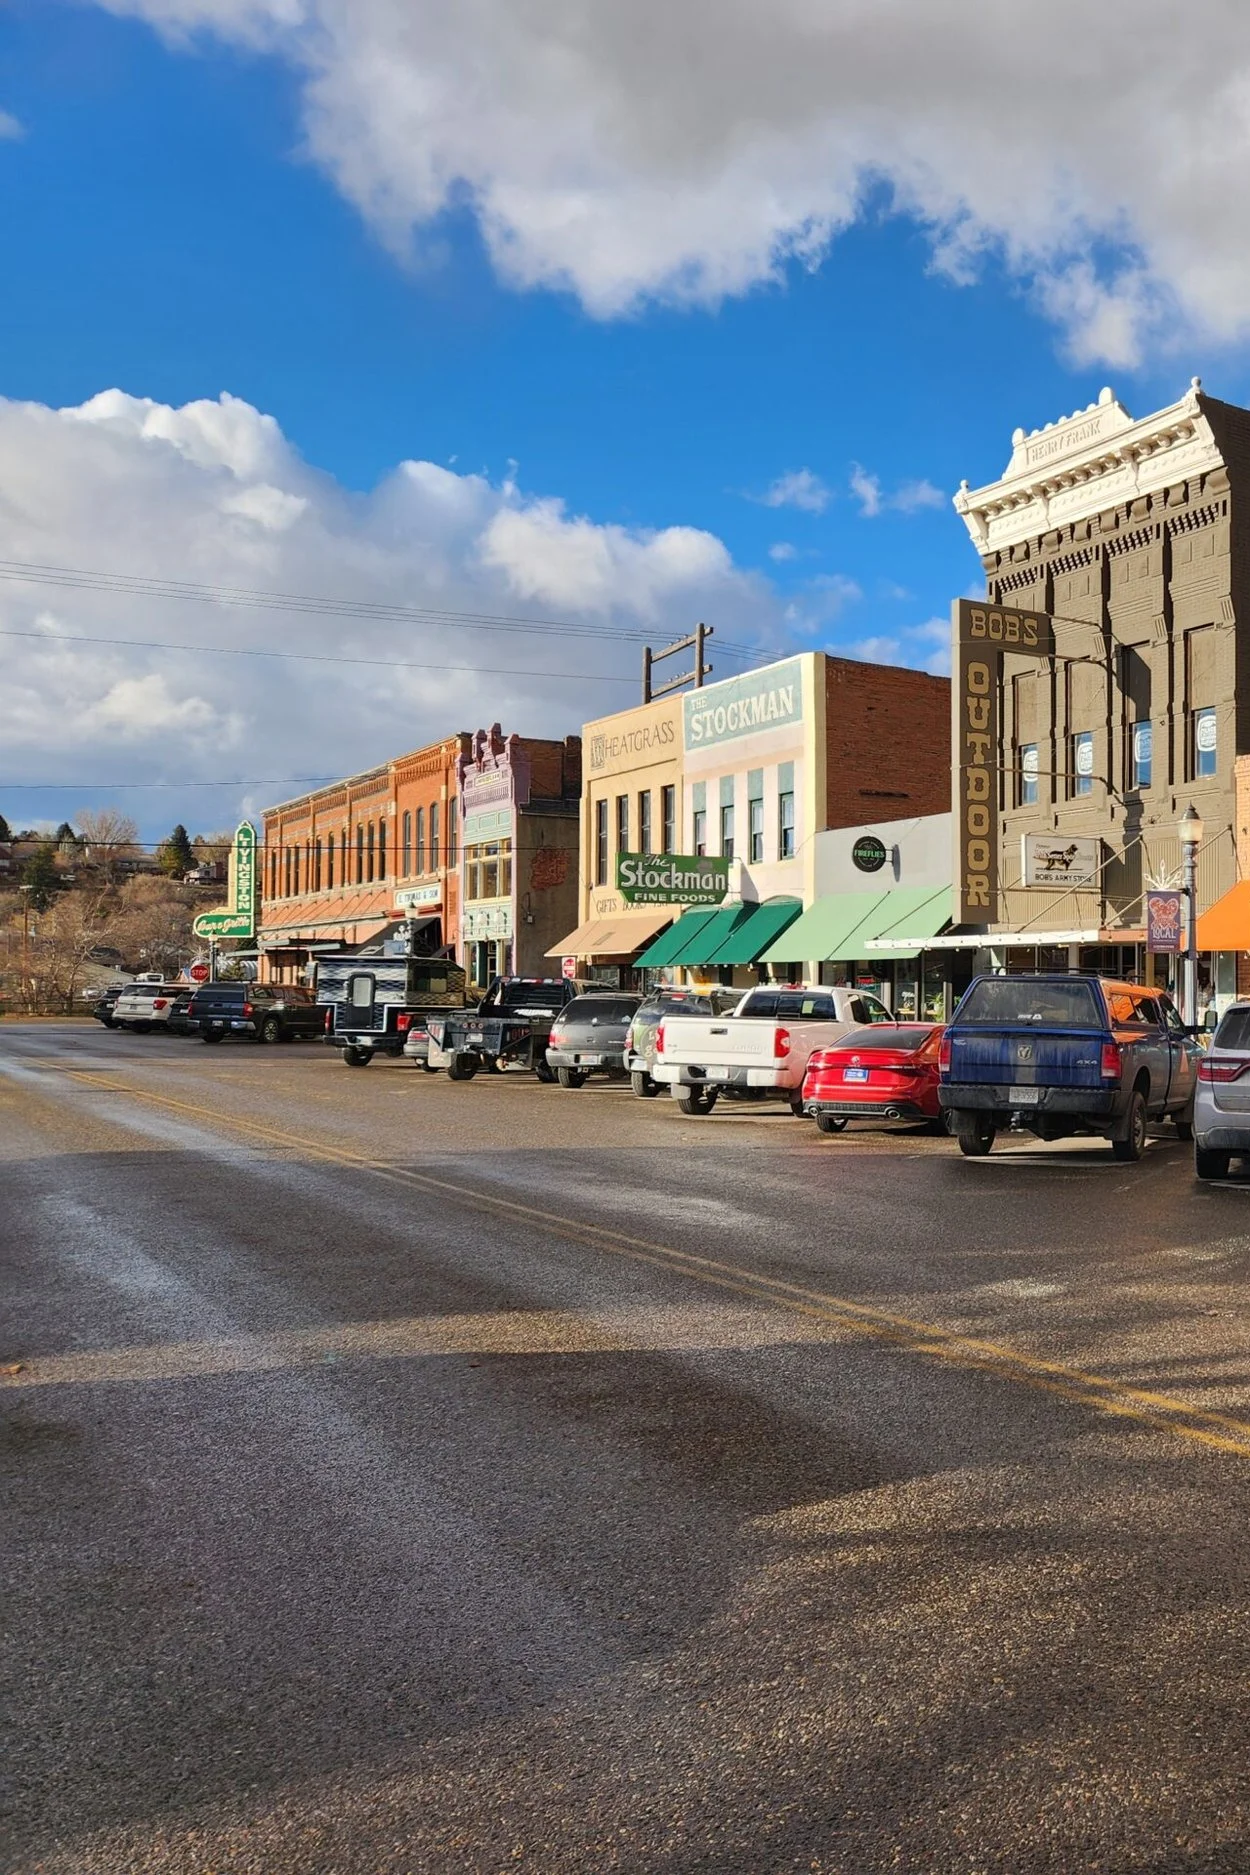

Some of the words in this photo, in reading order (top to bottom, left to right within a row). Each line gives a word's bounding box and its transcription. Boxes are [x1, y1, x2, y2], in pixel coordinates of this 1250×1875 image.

[1031, 436, 1064, 462] HENRY
[1066, 419, 1101, 447] FRANK
[970, 609, 1039, 647] BOB'S
[690, 695, 707, 711] THE
[690, 685, 794, 742] STOCKMAN
[966, 661, 991, 907] OUTDOOR
[644, 853, 670, 867] The
[854, 849, 885, 858] FIREFLIES
[238, 833, 251, 910] LIVINGSTON
[619, 860, 726, 891] Stockman
[634, 892, 667, 902] FINE
[671, 893, 716, 902] FOODS
[596, 898, 617, 914] GIFTS
[1152, 927, 1176, 939] LOCAL
[191, 968, 208, 978] STOP
